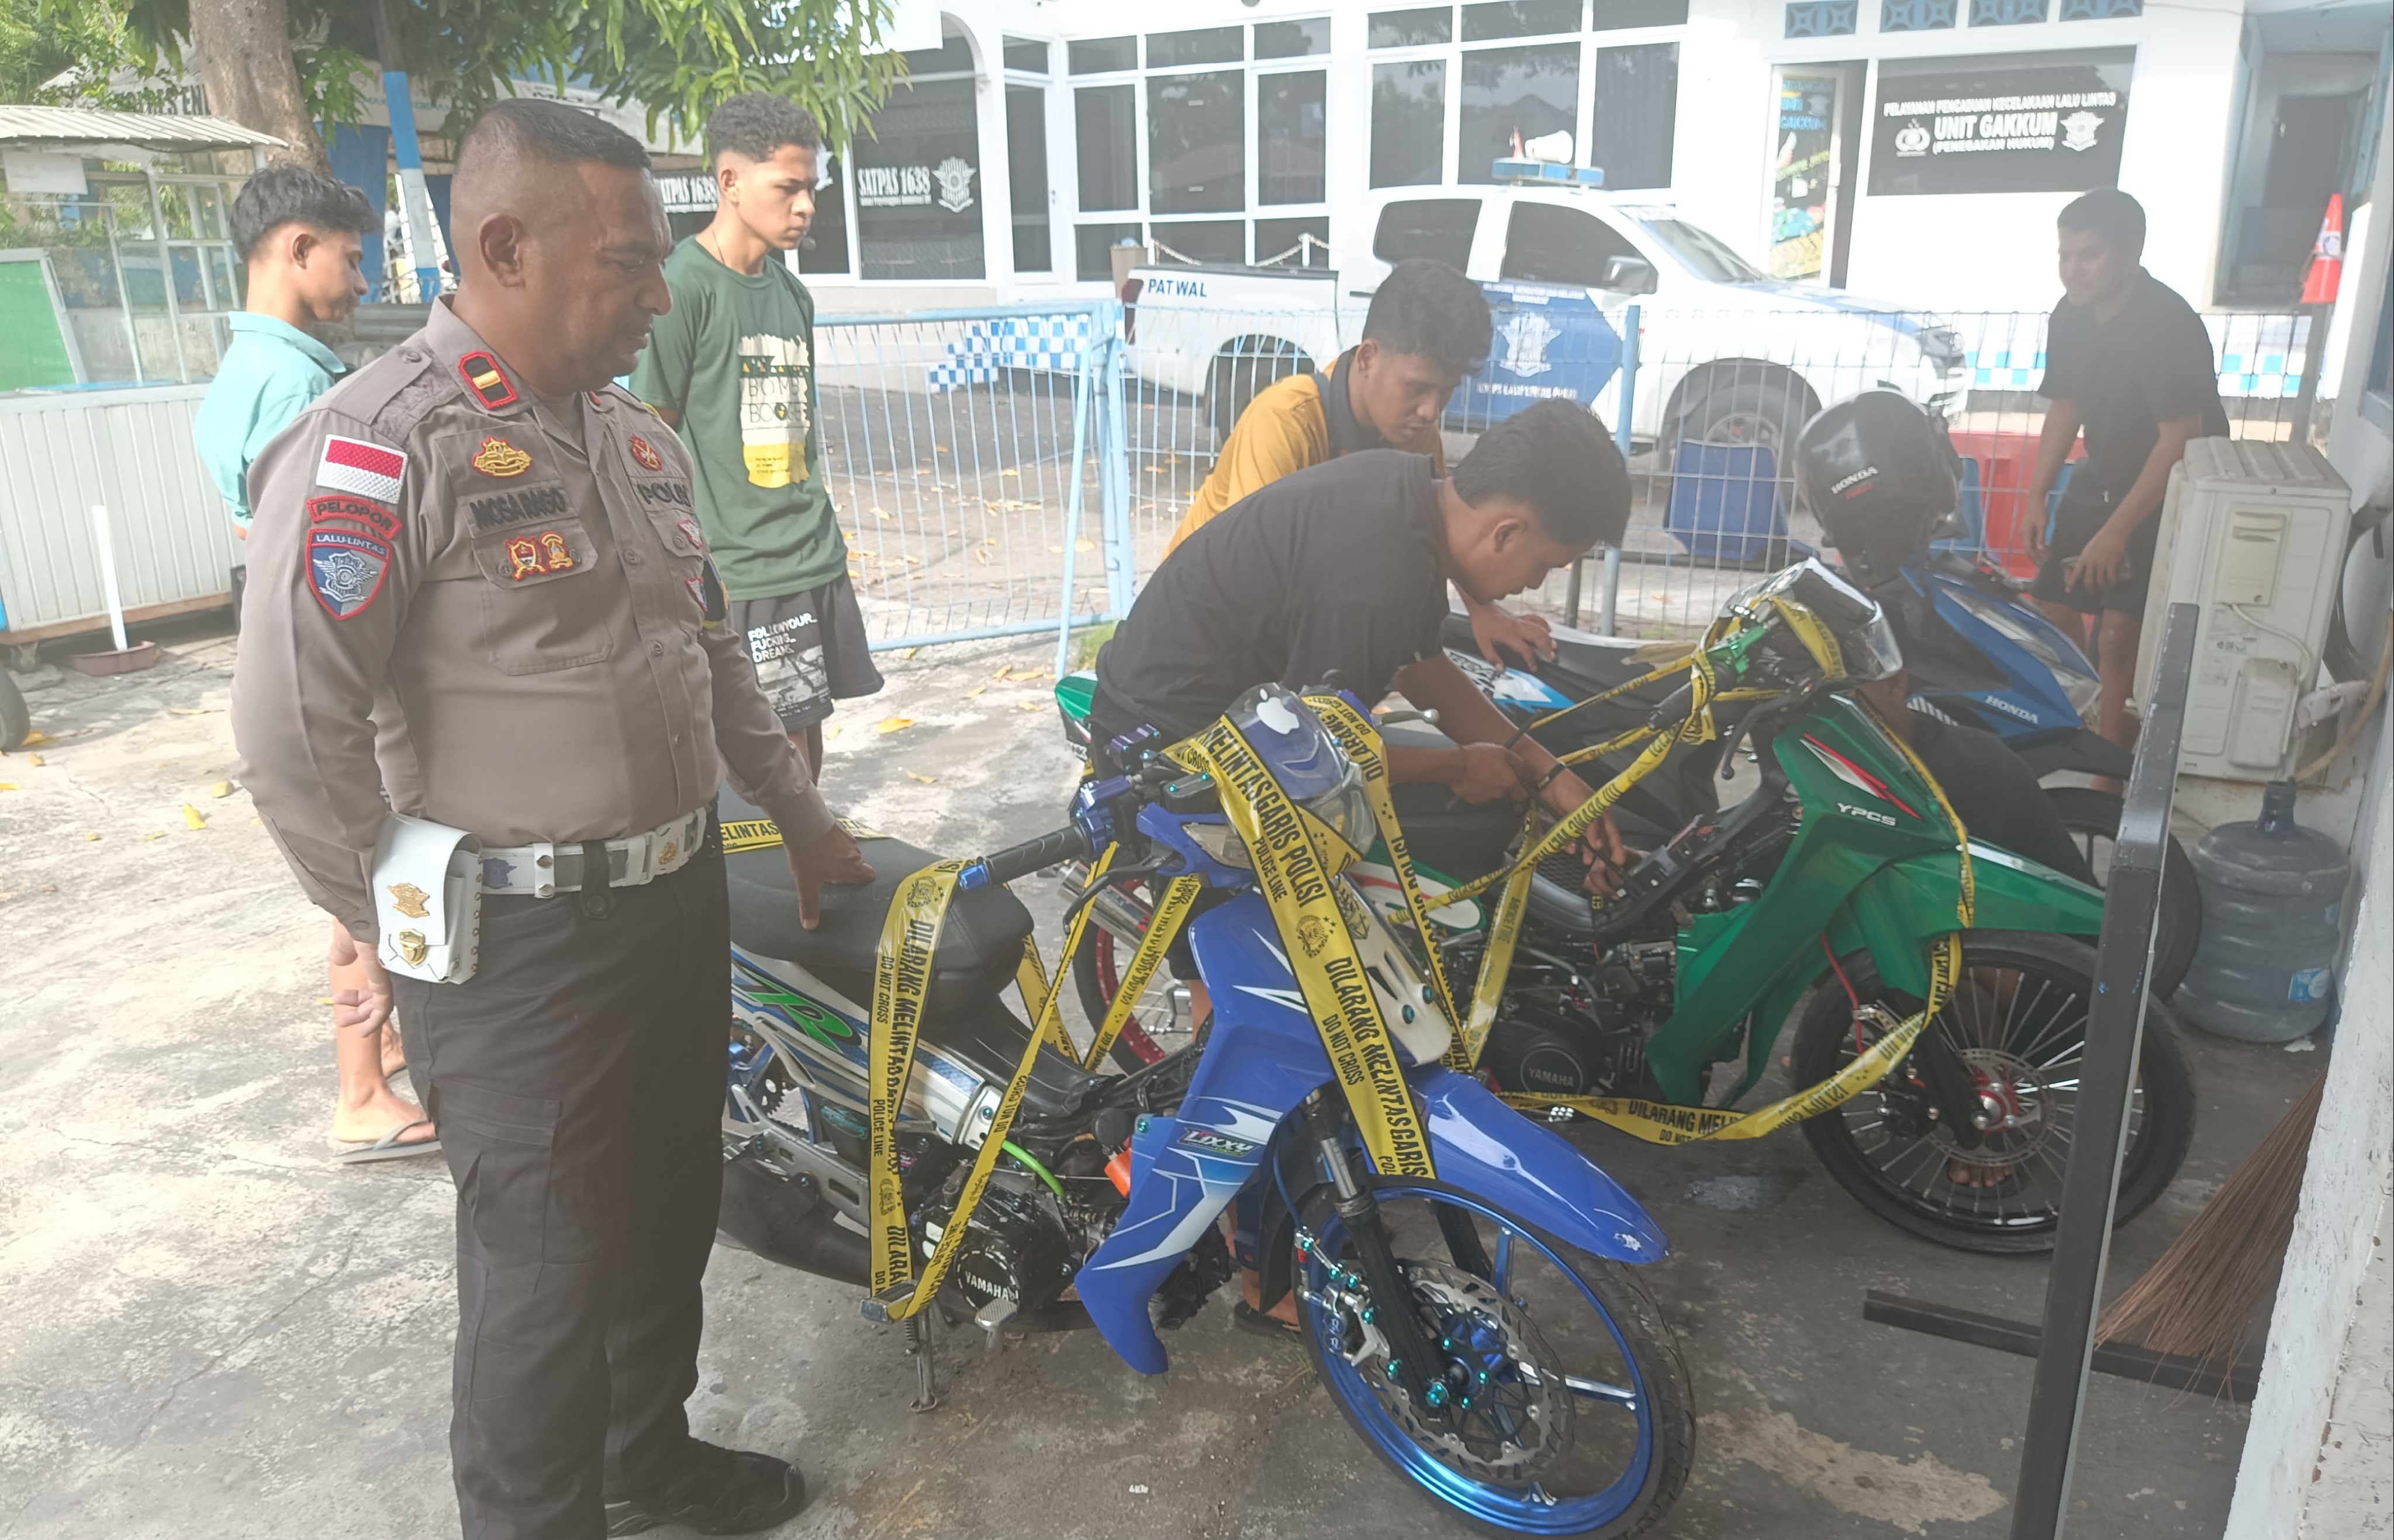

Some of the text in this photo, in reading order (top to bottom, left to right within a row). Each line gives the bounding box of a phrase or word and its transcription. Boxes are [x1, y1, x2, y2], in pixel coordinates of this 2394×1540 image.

[2055, 94, 2080, 108] LALU
[1934, 112, 2058, 140] UNIT GAKKUM
[857, 166, 931, 196] SATPAS 1638
[1148, 279, 1206, 297] PATWAL
[1831, 467, 1879, 494] HONDA
[317, 500, 392, 530] PELOPOR
[1985, 695, 2038, 724] HONDA
[1837, 802, 1896, 827] YPCS
[1252, 837, 1277, 878] POLICE
[1279, 845, 1326, 908] POLISI
[897, 919, 935, 996] DILARANG
[876, 955, 894, 1024] DO NOT CROSS
[1324, 957, 1380, 1043] DILARANG
[1322, 1014, 1364, 1086] DO NOT CROSS
[1529, 1067, 1574, 1087] YAMAHA
[873, 1100, 886, 1156] POLICE LINE
[1628, 1099, 1695, 1132] DILARANG
[1659, 1129, 1671, 1141] DO
[886, 1225, 908, 1287] DILARA
[875, 1271, 886, 1285] DO
[965, 1270, 1008, 1301] YAMAHA
